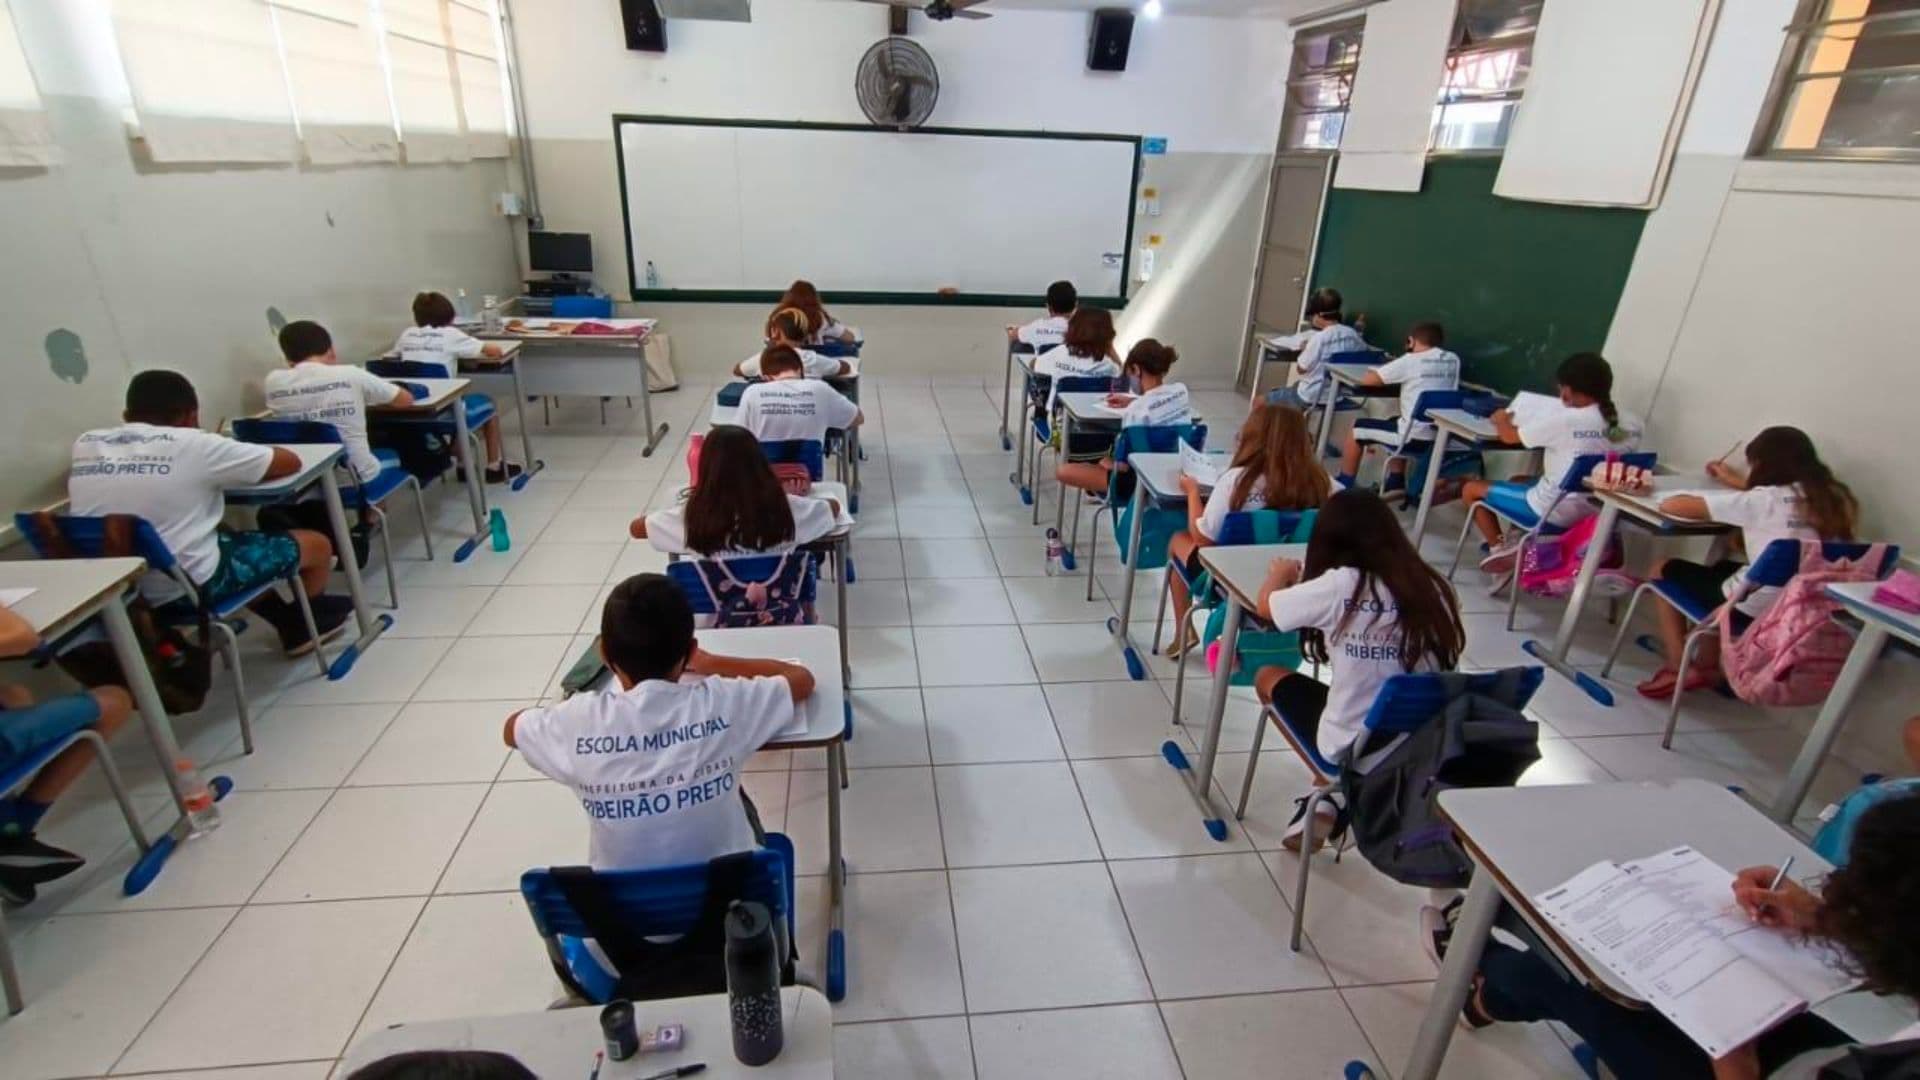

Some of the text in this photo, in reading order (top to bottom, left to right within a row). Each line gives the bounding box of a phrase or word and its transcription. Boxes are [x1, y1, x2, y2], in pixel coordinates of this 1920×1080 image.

[118, 463, 170, 475] PRETO
[1345, 643, 1399, 661] RIBEIR
[576, 735, 639, 755] ESCOLA
[666, 774, 685, 785] DA
[582, 772, 735, 819] RIBEIRÃO PRETO
